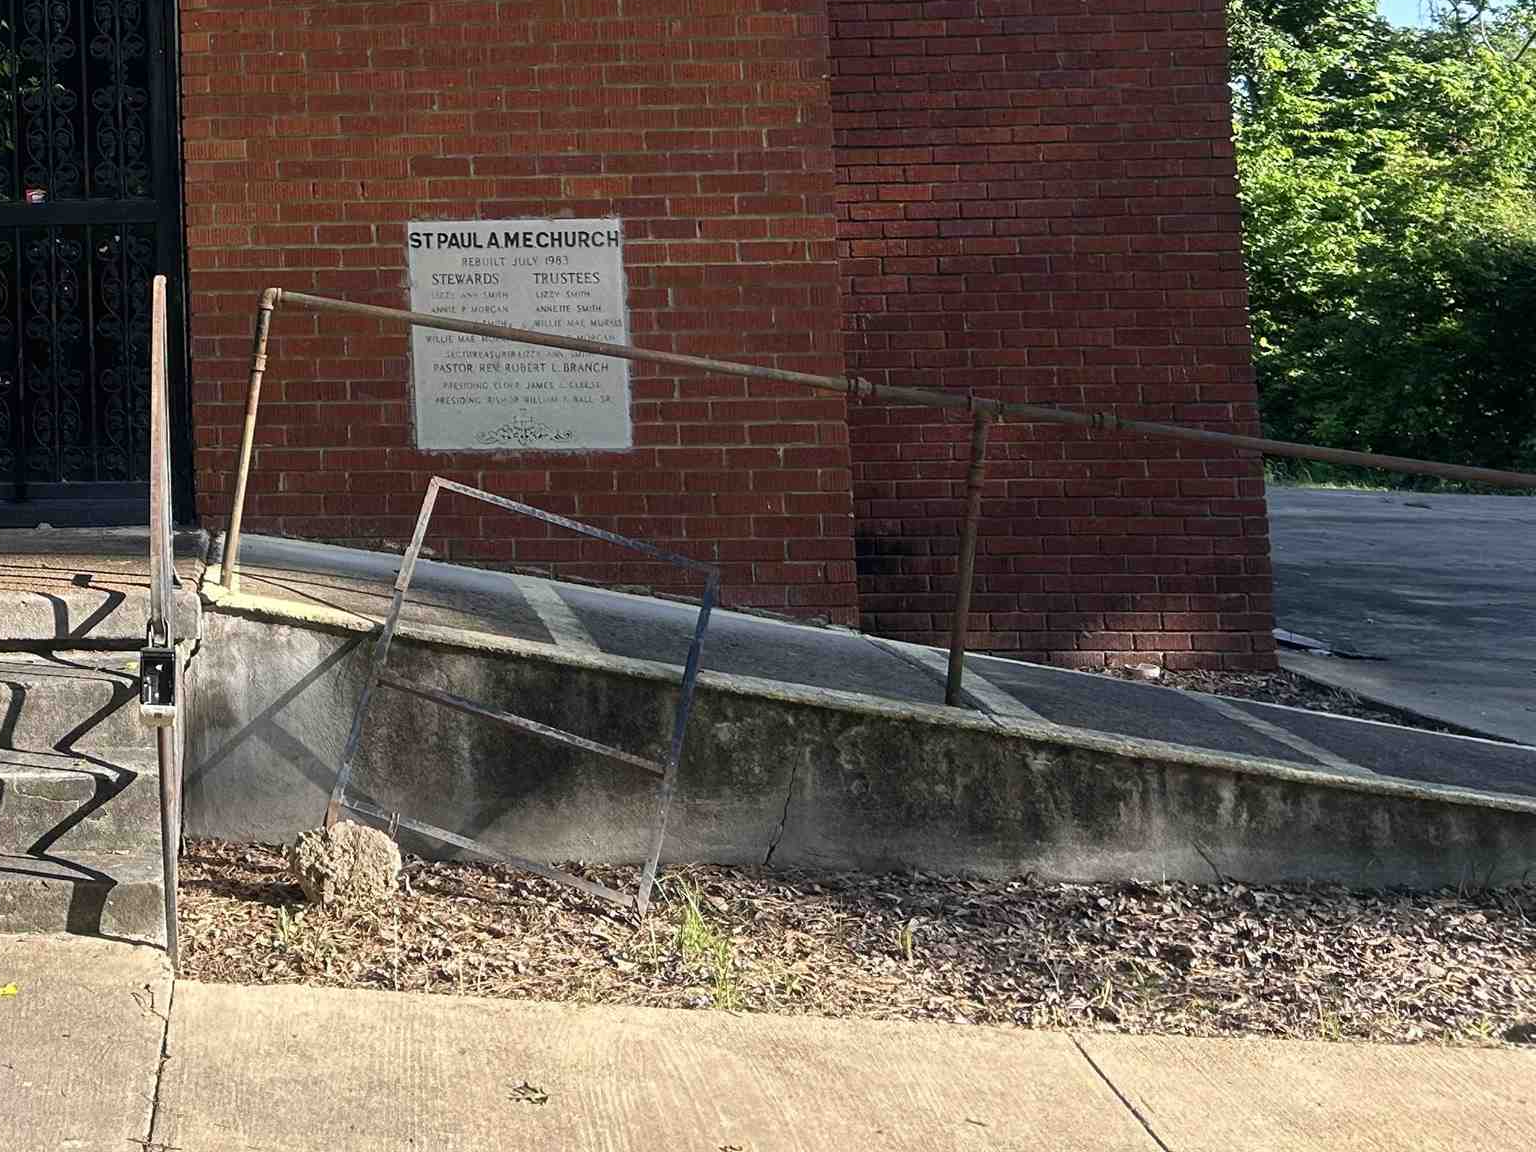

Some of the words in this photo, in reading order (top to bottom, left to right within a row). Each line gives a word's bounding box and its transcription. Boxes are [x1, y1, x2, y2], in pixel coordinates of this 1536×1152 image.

[409, 232, 433, 249] ST
[437, 232, 483, 248] PAUL
[536, 230, 619, 248] CHURCH
[462, 256, 505, 266] REBUILT
[512, 256, 538, 265] JULY
[545, 255, 569, 265] 1983
[432, 273, 499, 285] STEWARDS
[533, 272, 600, 284] TRUSTEES
[432, 363, 473, 373] PASTOR
[563, 362, 609, 373] BRANCH
